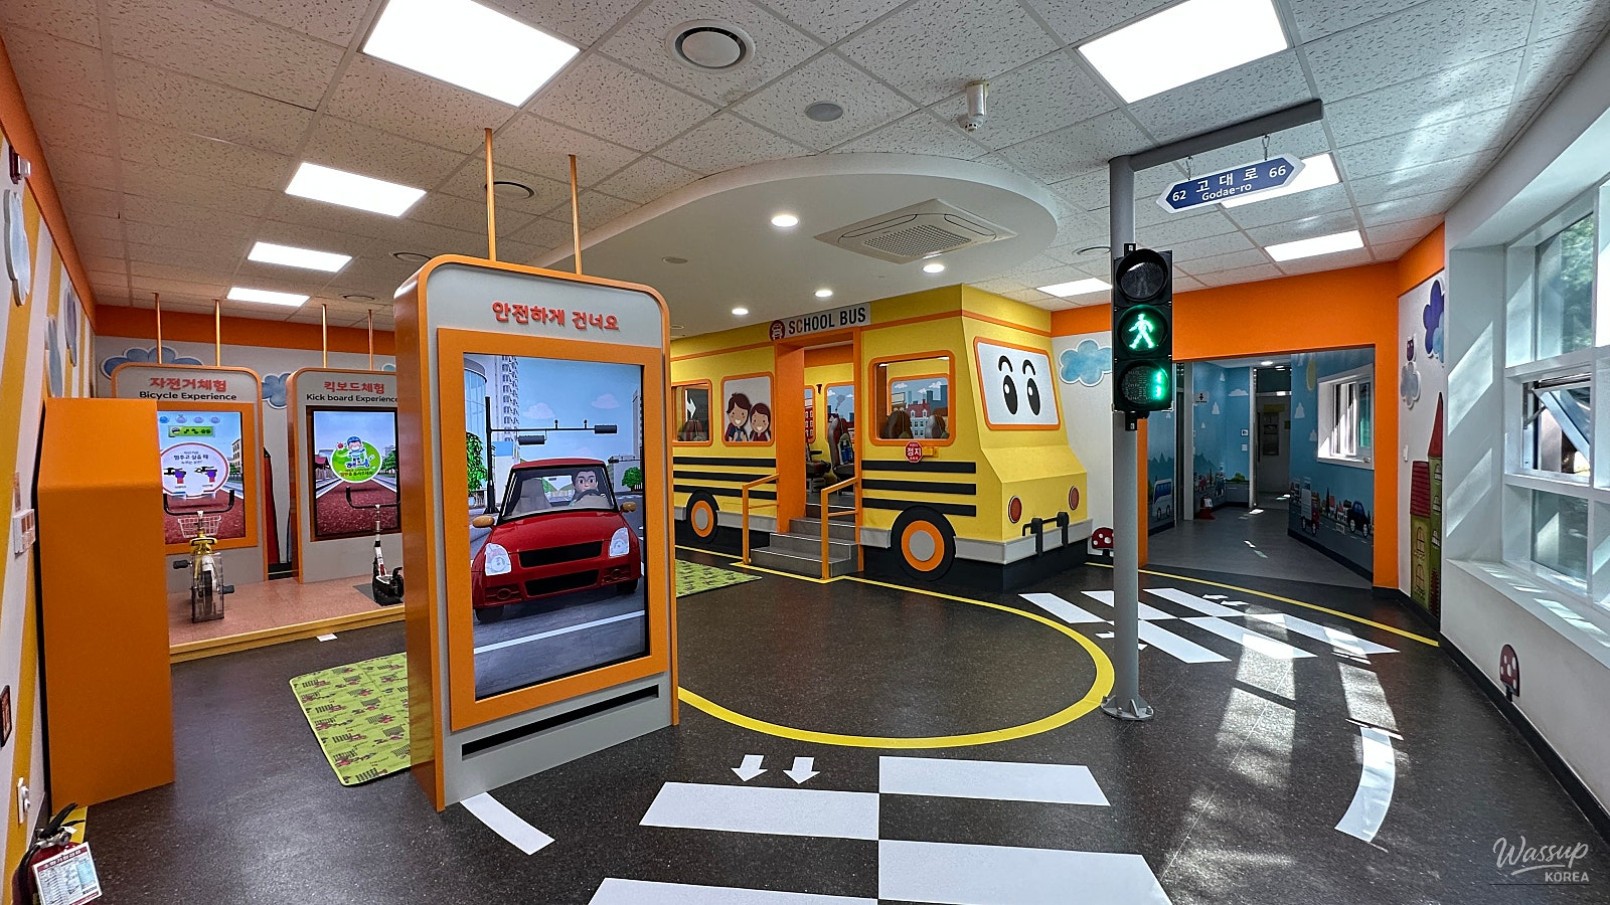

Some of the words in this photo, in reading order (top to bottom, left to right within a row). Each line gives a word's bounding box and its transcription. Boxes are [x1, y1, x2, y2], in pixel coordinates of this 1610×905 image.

[1172, 190, 1187, 201] 62
[1268, 165, 1287, 178] 66
[1201, 183, 1252, 201] Godae-ro
[492, 301, 566, 325] 안전하게
[571, 311, 620, 331] 건너요
[788, 313, 835, 335] SCHOOL
[839, 307, 866, 326] BUS
[149, 377, 227, 393] 자전거체험
[324, 381, 385, 395] 킥보드체험
[139, 391, 179, 401] Bicycle
[181, 392, 237, 401] Experience
[306, 393, 325, 401] Kick
[327, 394, 353, 402] board
[907, 447, 922, 457] 정지
